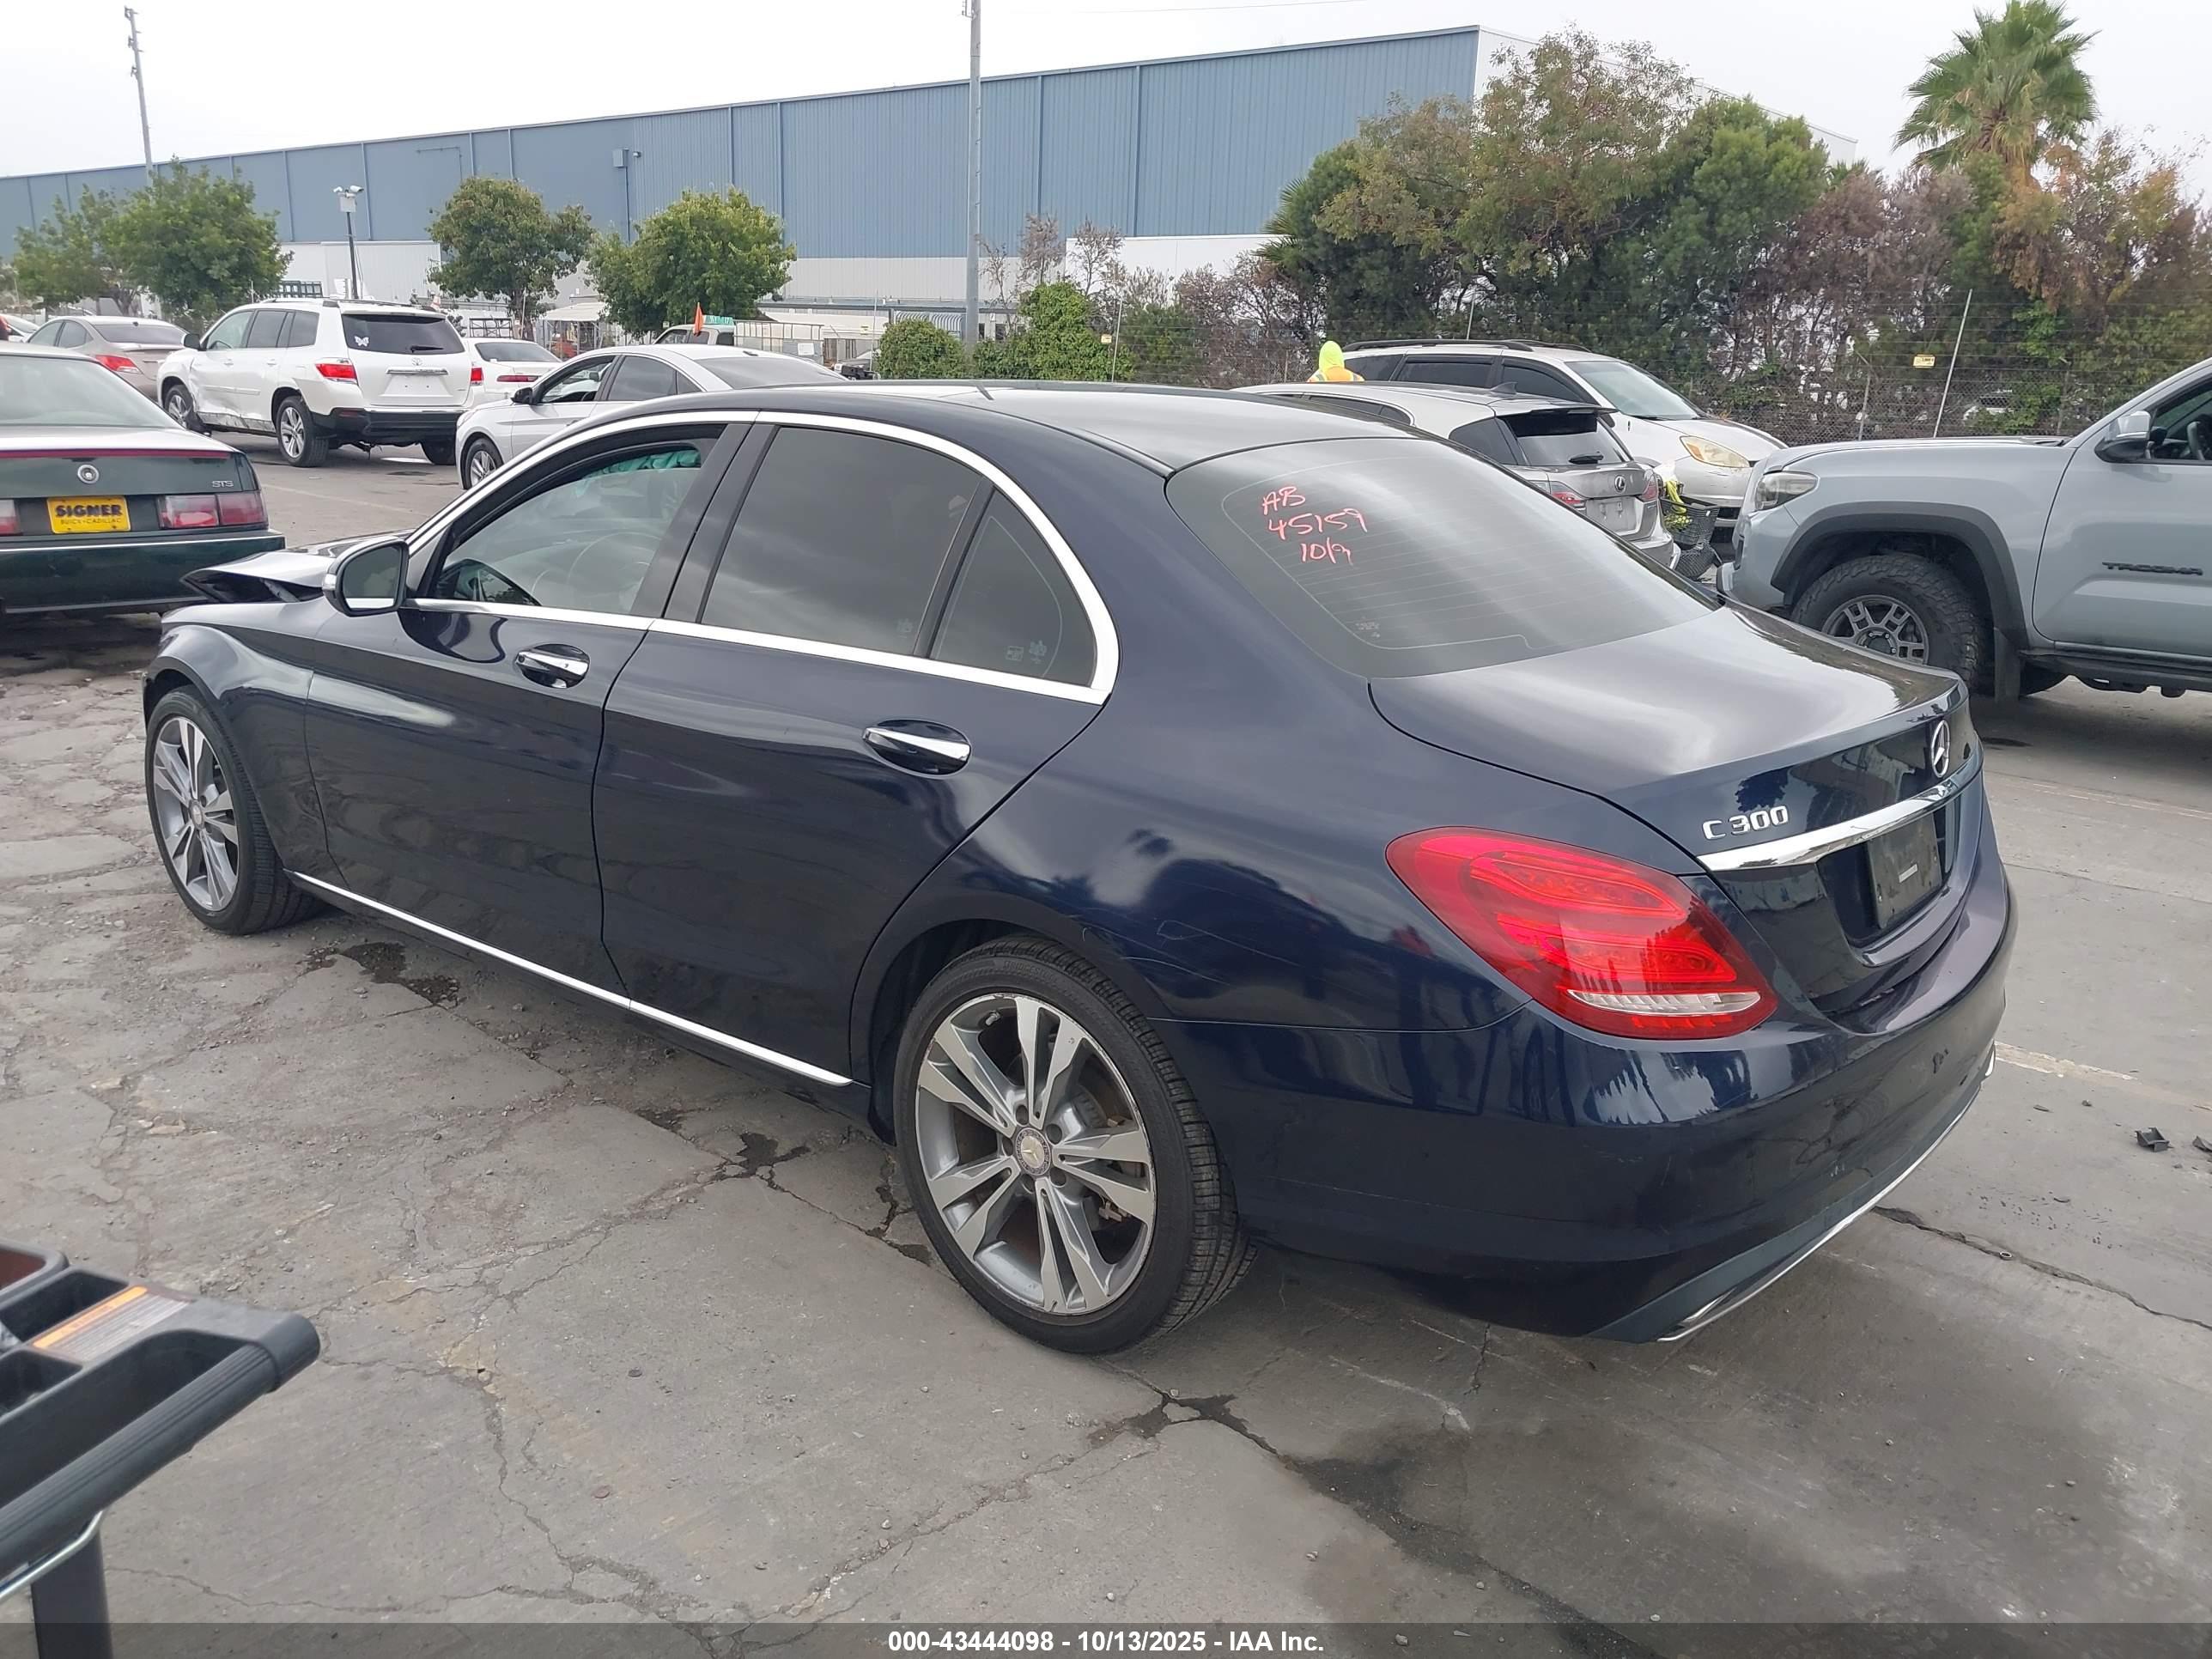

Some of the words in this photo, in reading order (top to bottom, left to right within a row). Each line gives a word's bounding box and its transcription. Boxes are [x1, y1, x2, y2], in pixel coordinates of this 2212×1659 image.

[55, 504, 123, 517] SIGNER
[1261, 486, 1306, 516] AB
[1268, 507, 1368, 540] 45159
[1702, 819, 1727, 840] C
[1727, 805, 1789, 836] 300
